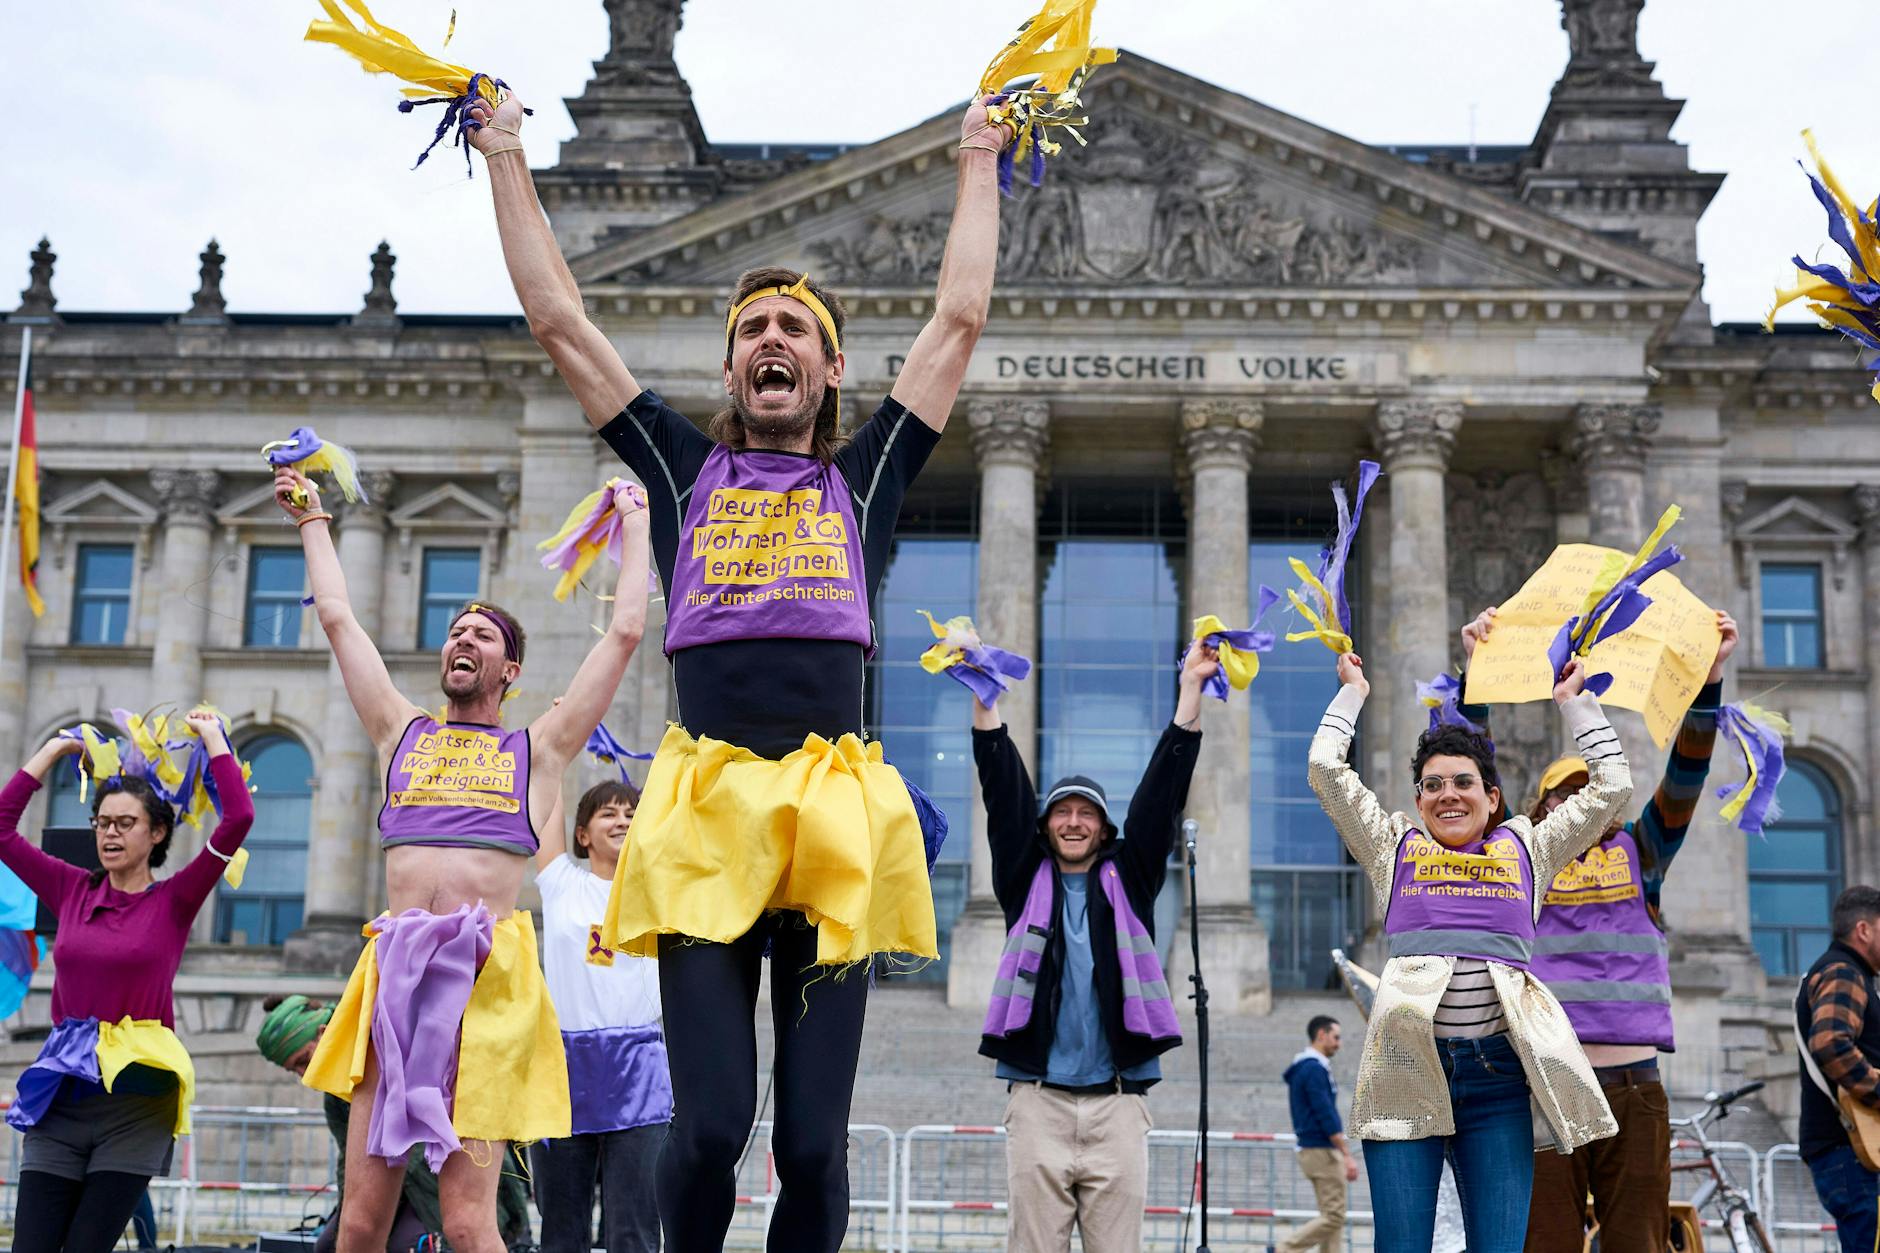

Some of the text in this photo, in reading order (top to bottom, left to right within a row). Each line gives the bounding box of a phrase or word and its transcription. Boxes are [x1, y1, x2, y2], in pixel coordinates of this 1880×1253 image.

[997, 355, 1347, 380] DEUTSCHEN VOLKE
[697, 518, 842, 551] Wohnen & Co
[711, 553, 844, 579] enteignen!
[685, 582, 855, 607] Hier unterschreiben
[475, 753, 486, 766] &
[492, 753, 512, 768] Co
[414, 772, 510, 789] enteignen!
[1420, 860, 1518, 880] enteignen!
[1400, 884, 1526, 901] Hier unterschreiben
